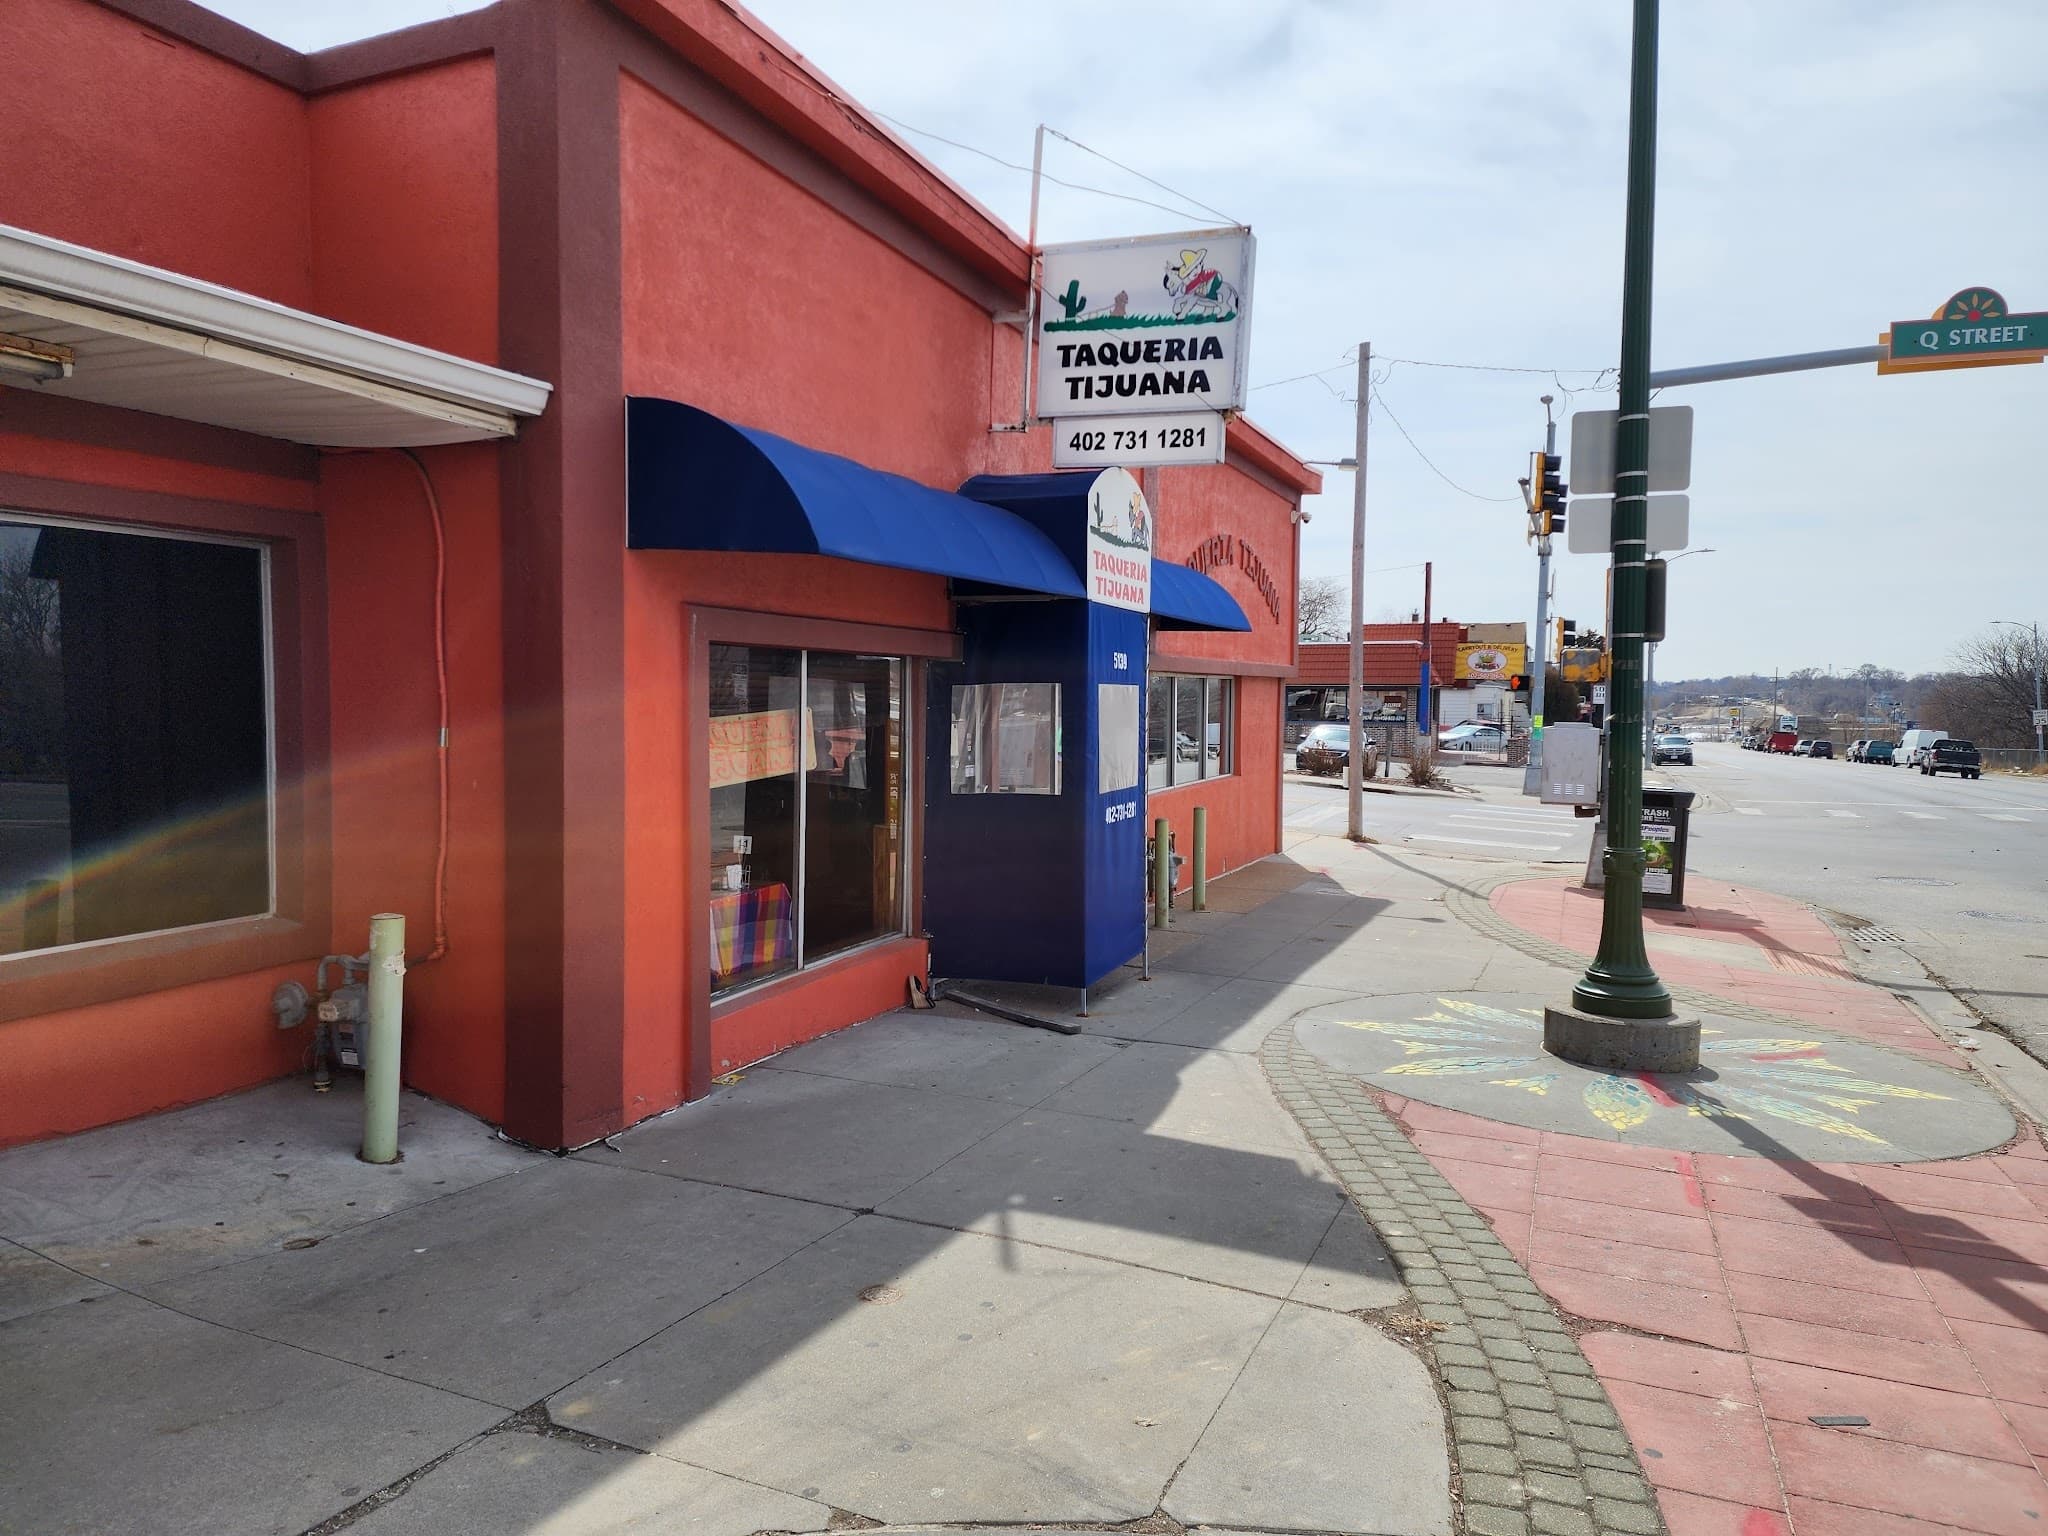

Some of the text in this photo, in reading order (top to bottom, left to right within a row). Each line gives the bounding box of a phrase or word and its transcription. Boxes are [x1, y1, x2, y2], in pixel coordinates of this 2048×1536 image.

[1056, 336, 1224, 368] TAQUERIA
[1919, 325, 2028, 350] Q STREET
[1065, 369, 1211, 400] TIJUANA
[1069, 427, 1206, 452] 402 731 1281
[1093, 550, 1148, 583] TAQUERIA
[1185, 533, 1280, 625] QUERIA TIJUANA
[1095, 575, 1145, 605] TIJUANA
[1113, 651, 1128, 671] 5139
